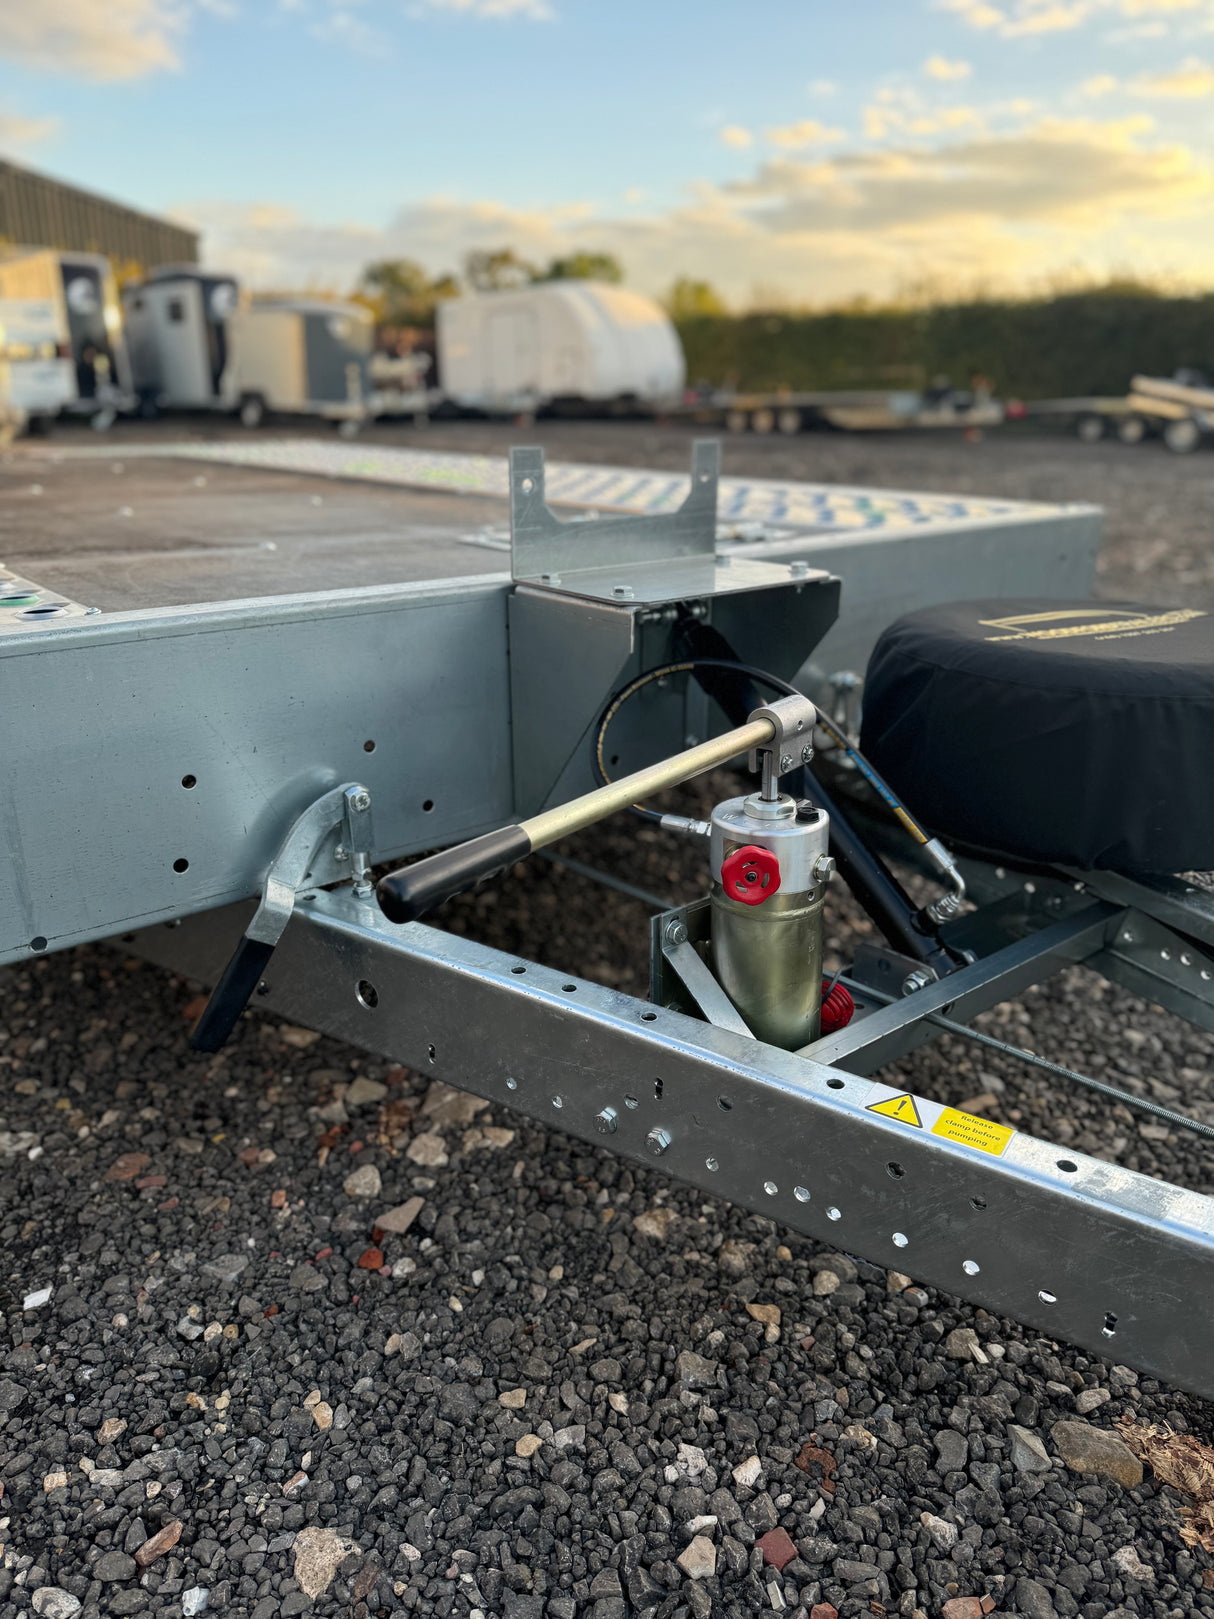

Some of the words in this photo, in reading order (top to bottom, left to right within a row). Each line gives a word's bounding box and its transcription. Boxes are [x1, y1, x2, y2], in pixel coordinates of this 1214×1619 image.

[945, 1119, 971, 1131] clamp
[972, 1128, 1001, 1141] before
[960, 1115, 994, 1130] Release
[947, 1129, 988, 1147] pumping
